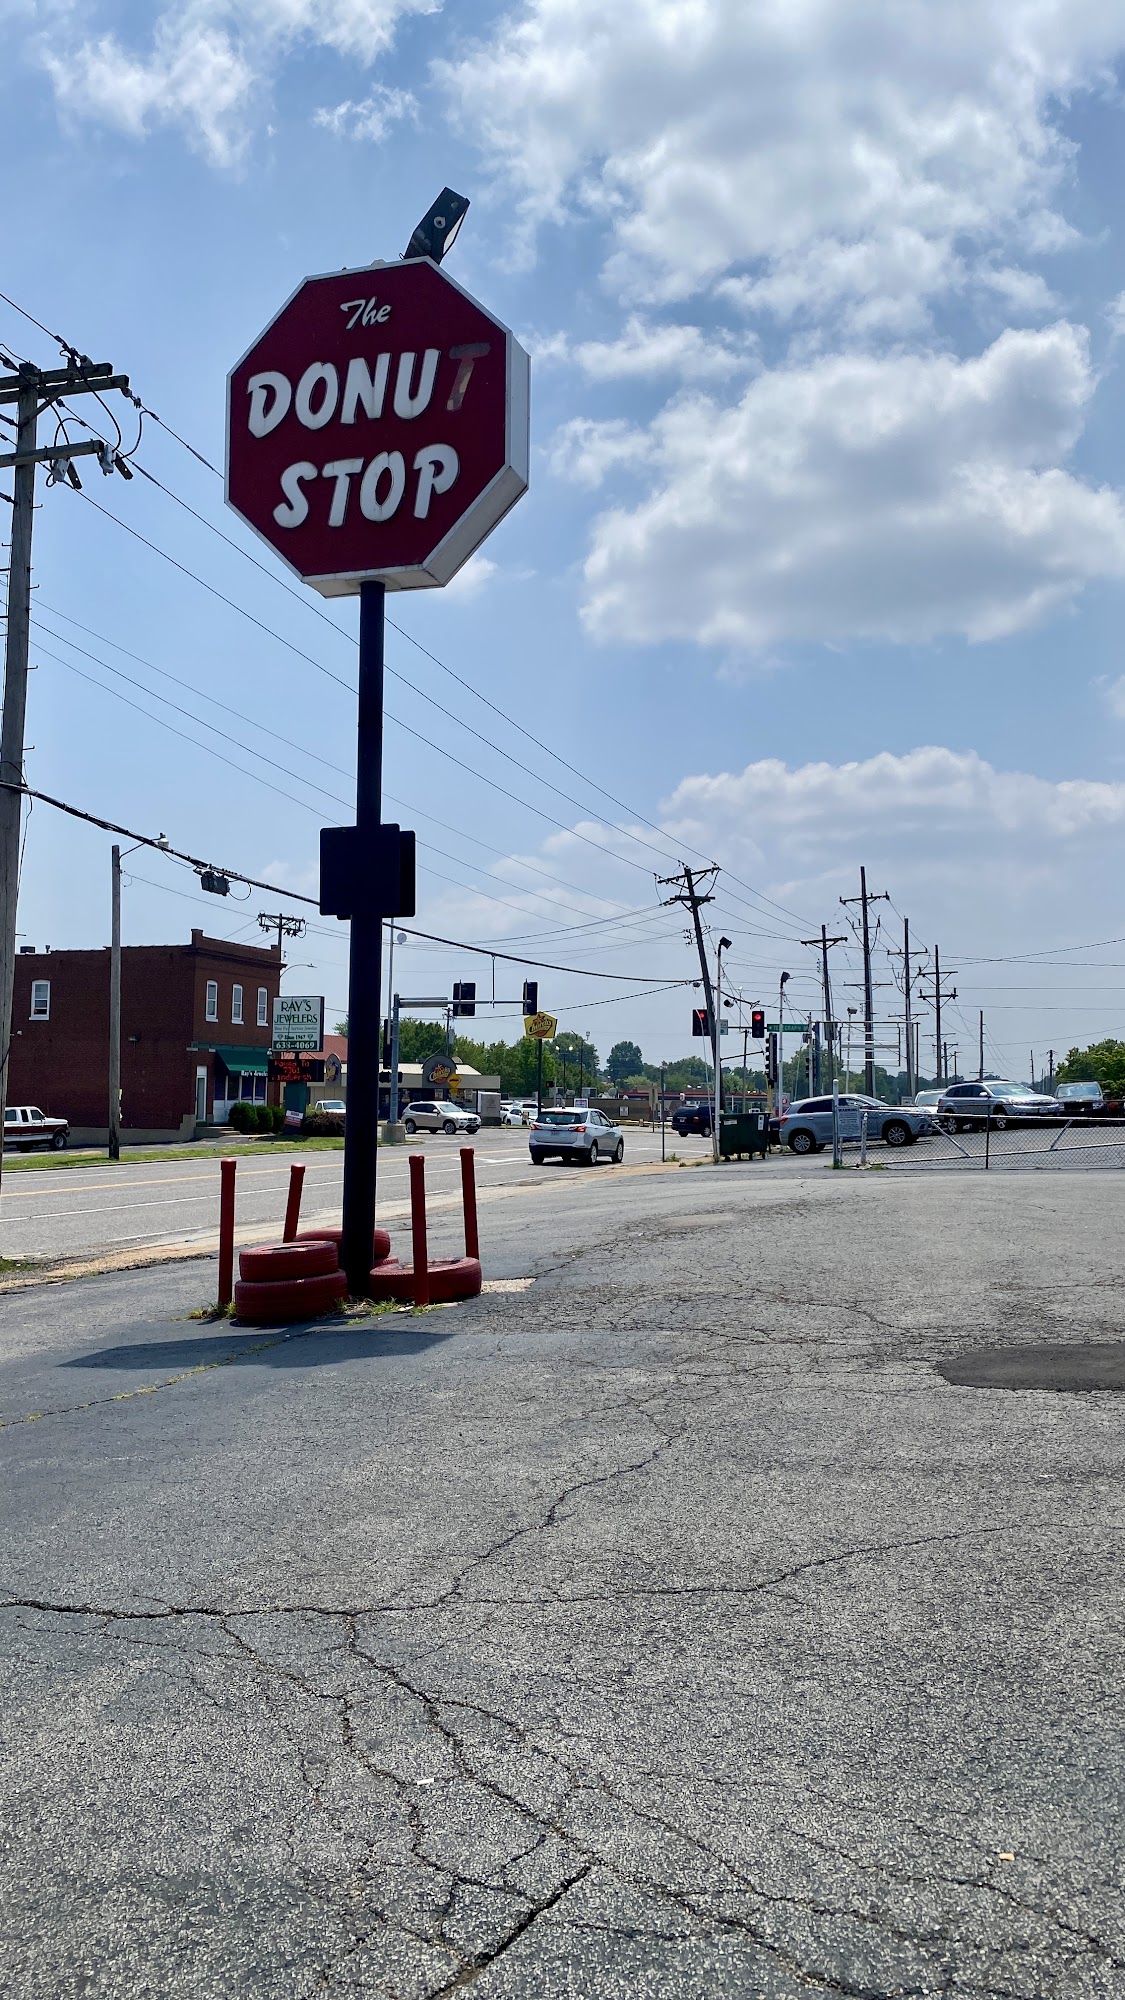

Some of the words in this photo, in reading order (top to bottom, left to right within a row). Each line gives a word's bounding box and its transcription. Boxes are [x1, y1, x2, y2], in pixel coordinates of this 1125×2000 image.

[340, 297, 391, 329] The
[246, 343, 491, 438] DONUT
[273, 443, 459, 529] STOP
[275, 1014, 317, 1024] JEWELERS
[281, 1000, 311, 1012] RAY'S
